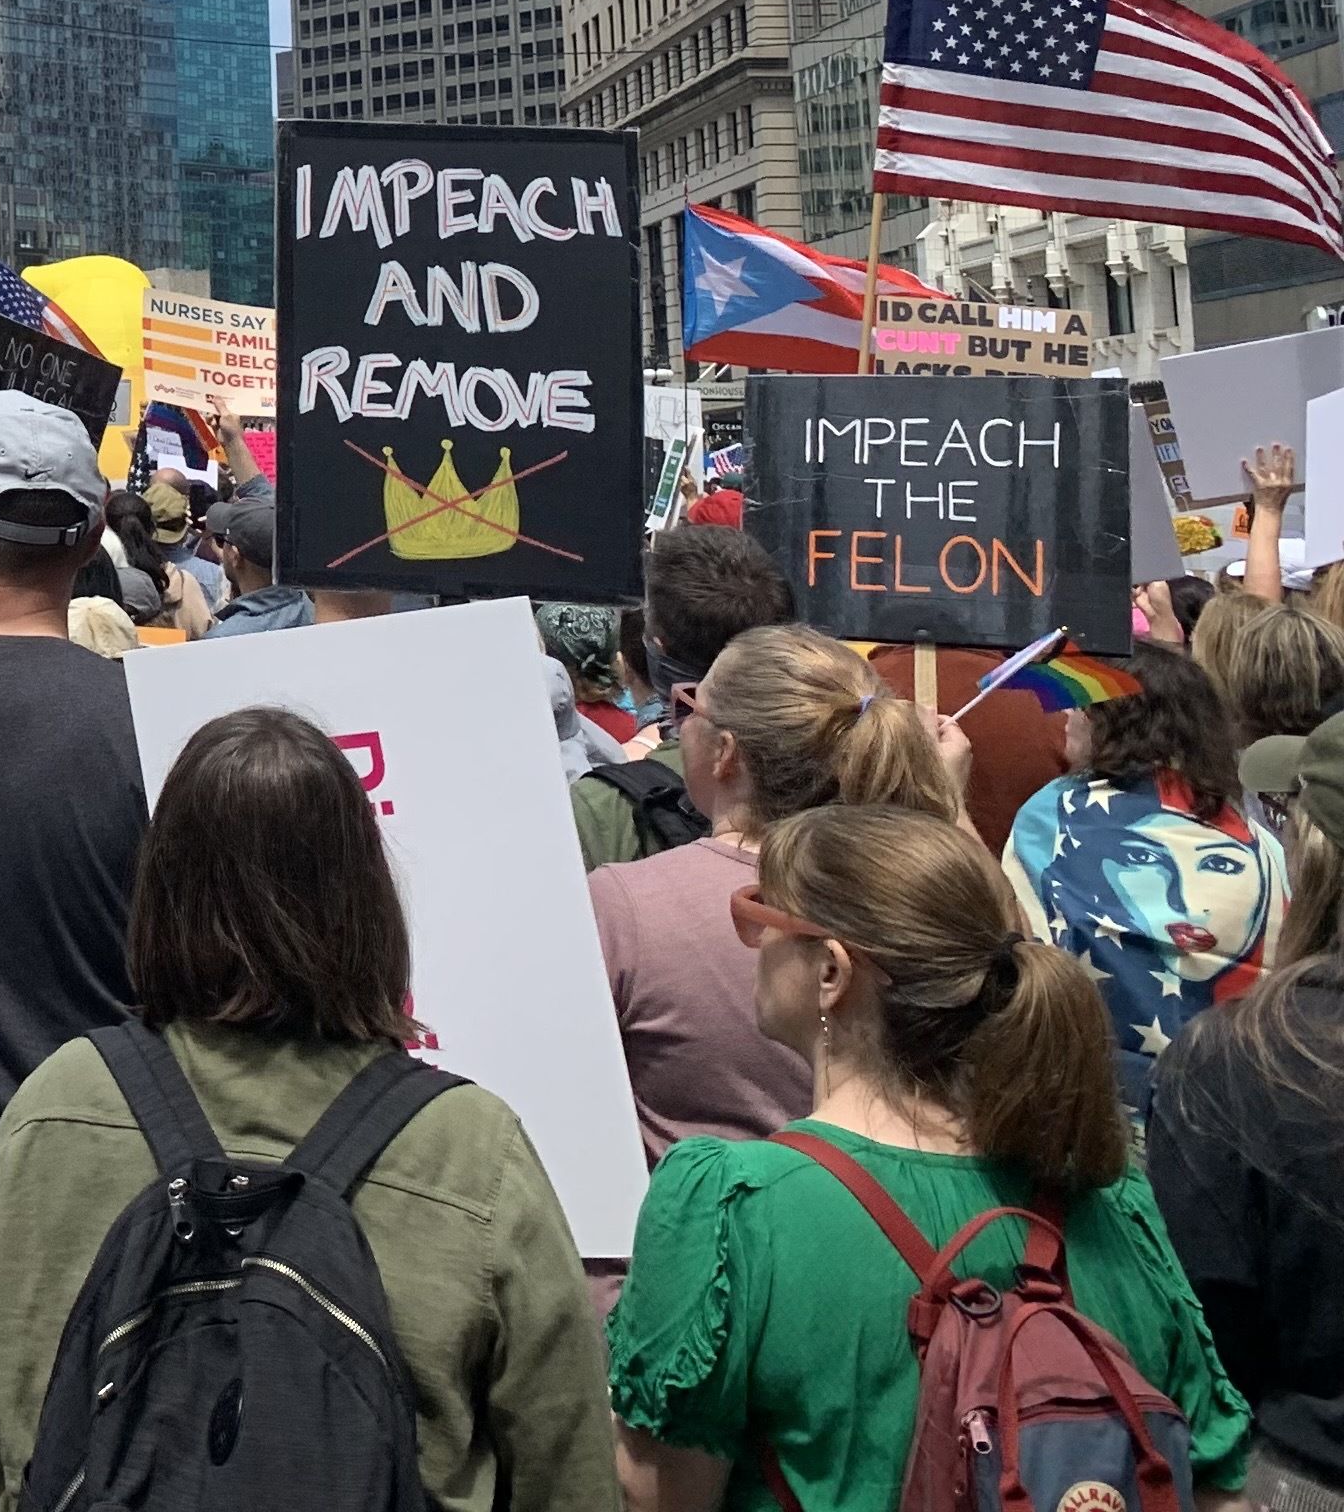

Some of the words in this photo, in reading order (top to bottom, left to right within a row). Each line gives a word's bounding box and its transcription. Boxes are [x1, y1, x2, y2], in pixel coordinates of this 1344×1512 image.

[295, 157, 623, 249] IMPEACH
[150, 298, 224, 325] NURSES
[230, 313, 267, 330] SAY
[364, 260, 539, 334] AND
[878, 300, 912, 323] ID
[917, 303, 994, 327] CALL
[998, 306, 1056, 334] HIM
[1063, 314, 1088, 336] A
[5, 337, 34, 369] NO
[40, 352, 78, 387] ONE
[875, 328, 962, 356] CUNT
[968, 335, 1032, 362] BUT
[1044, 342, 1089, 366] HE
[298, 345, 596, 434] REMOVE
[804, 417, 1060, 468] IMPEACH
[864, 478, 979, 523] THE
[807, 529, 1044, 596] FELON
